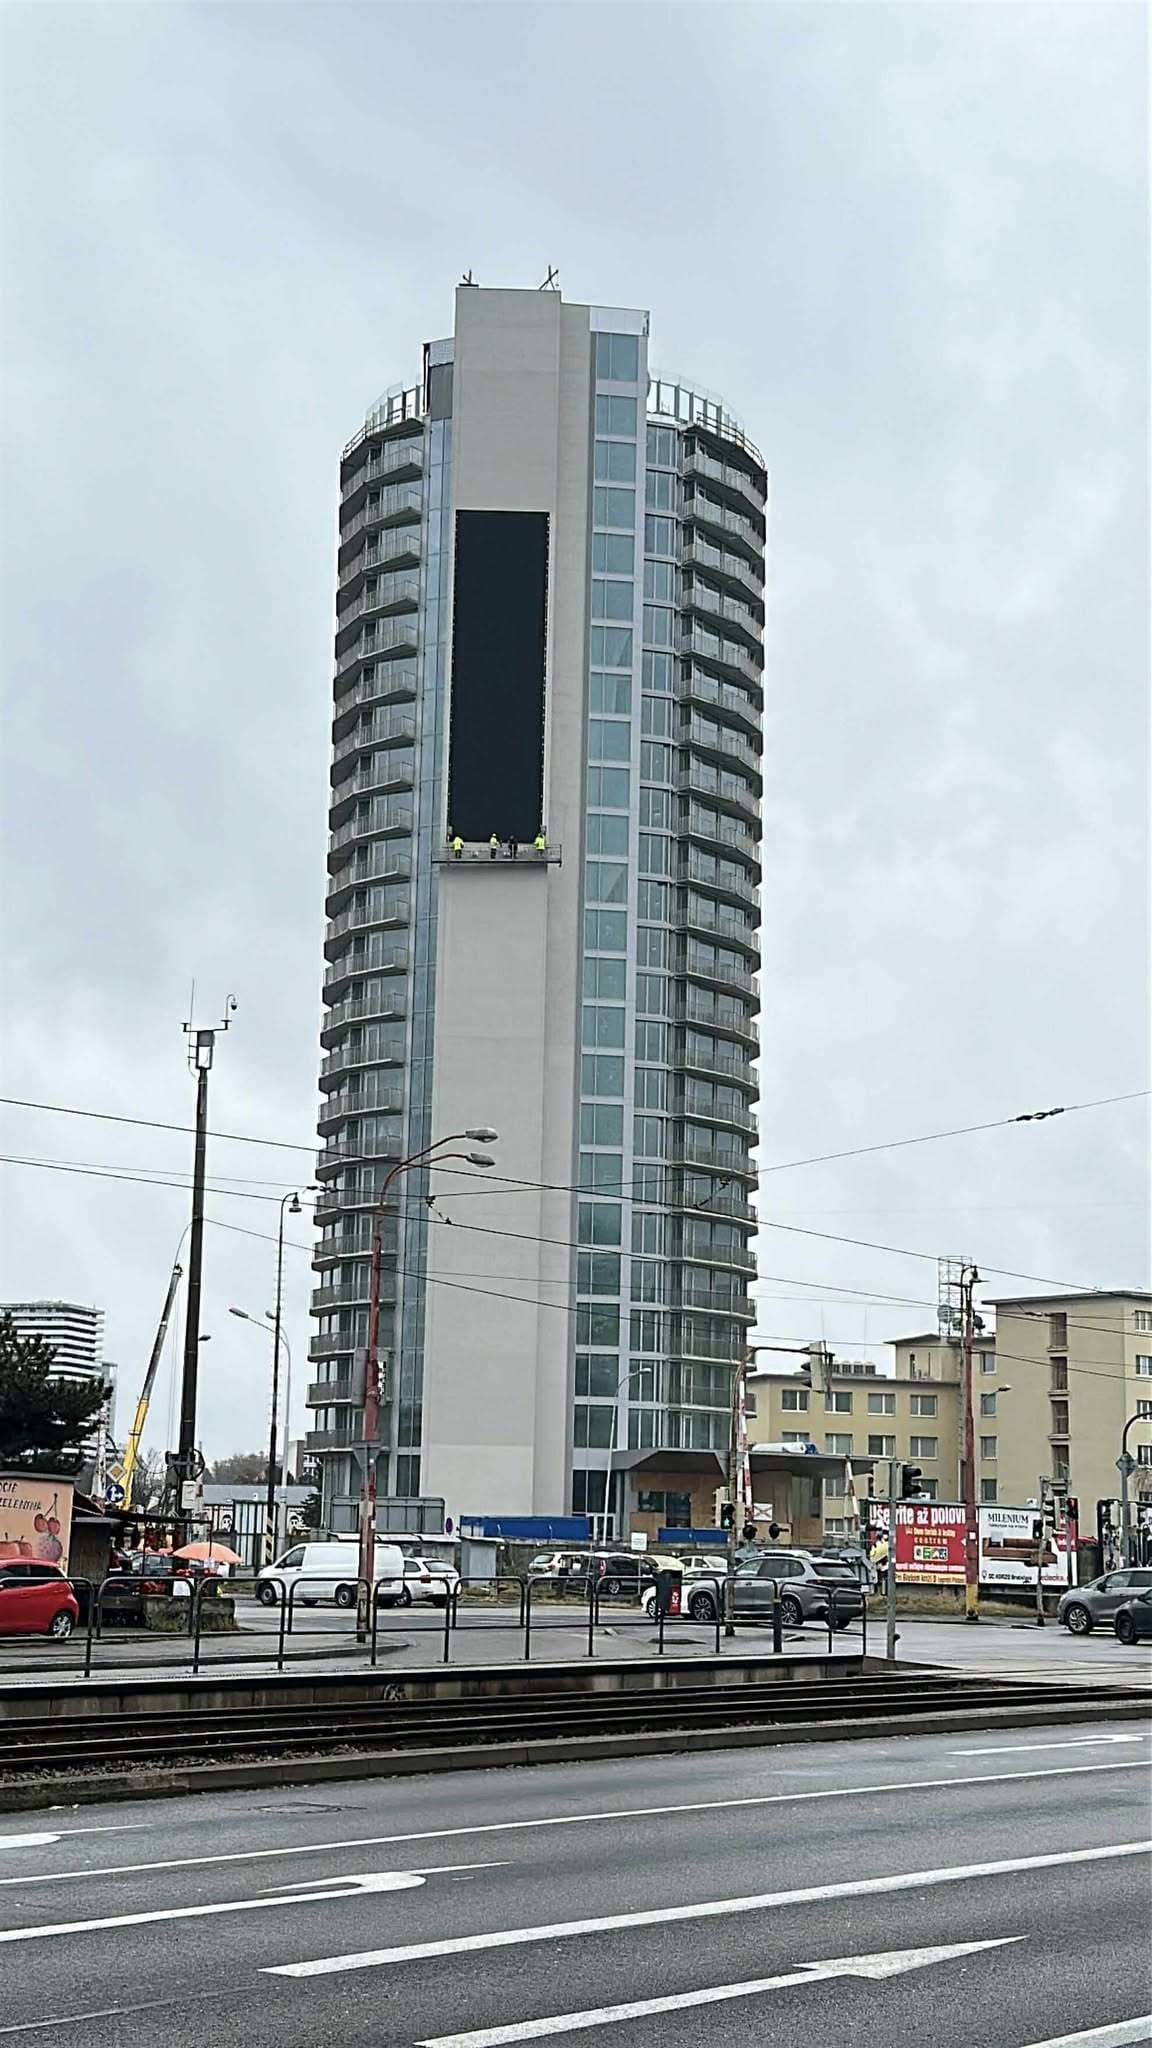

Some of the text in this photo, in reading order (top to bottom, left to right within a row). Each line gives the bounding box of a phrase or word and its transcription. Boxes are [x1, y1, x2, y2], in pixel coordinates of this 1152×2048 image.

[869, 1504, 914, 1525] Ušerite
[917, 1507, 929, 1524] až
[987, 1513, 1029, 1524] MILENIUM
